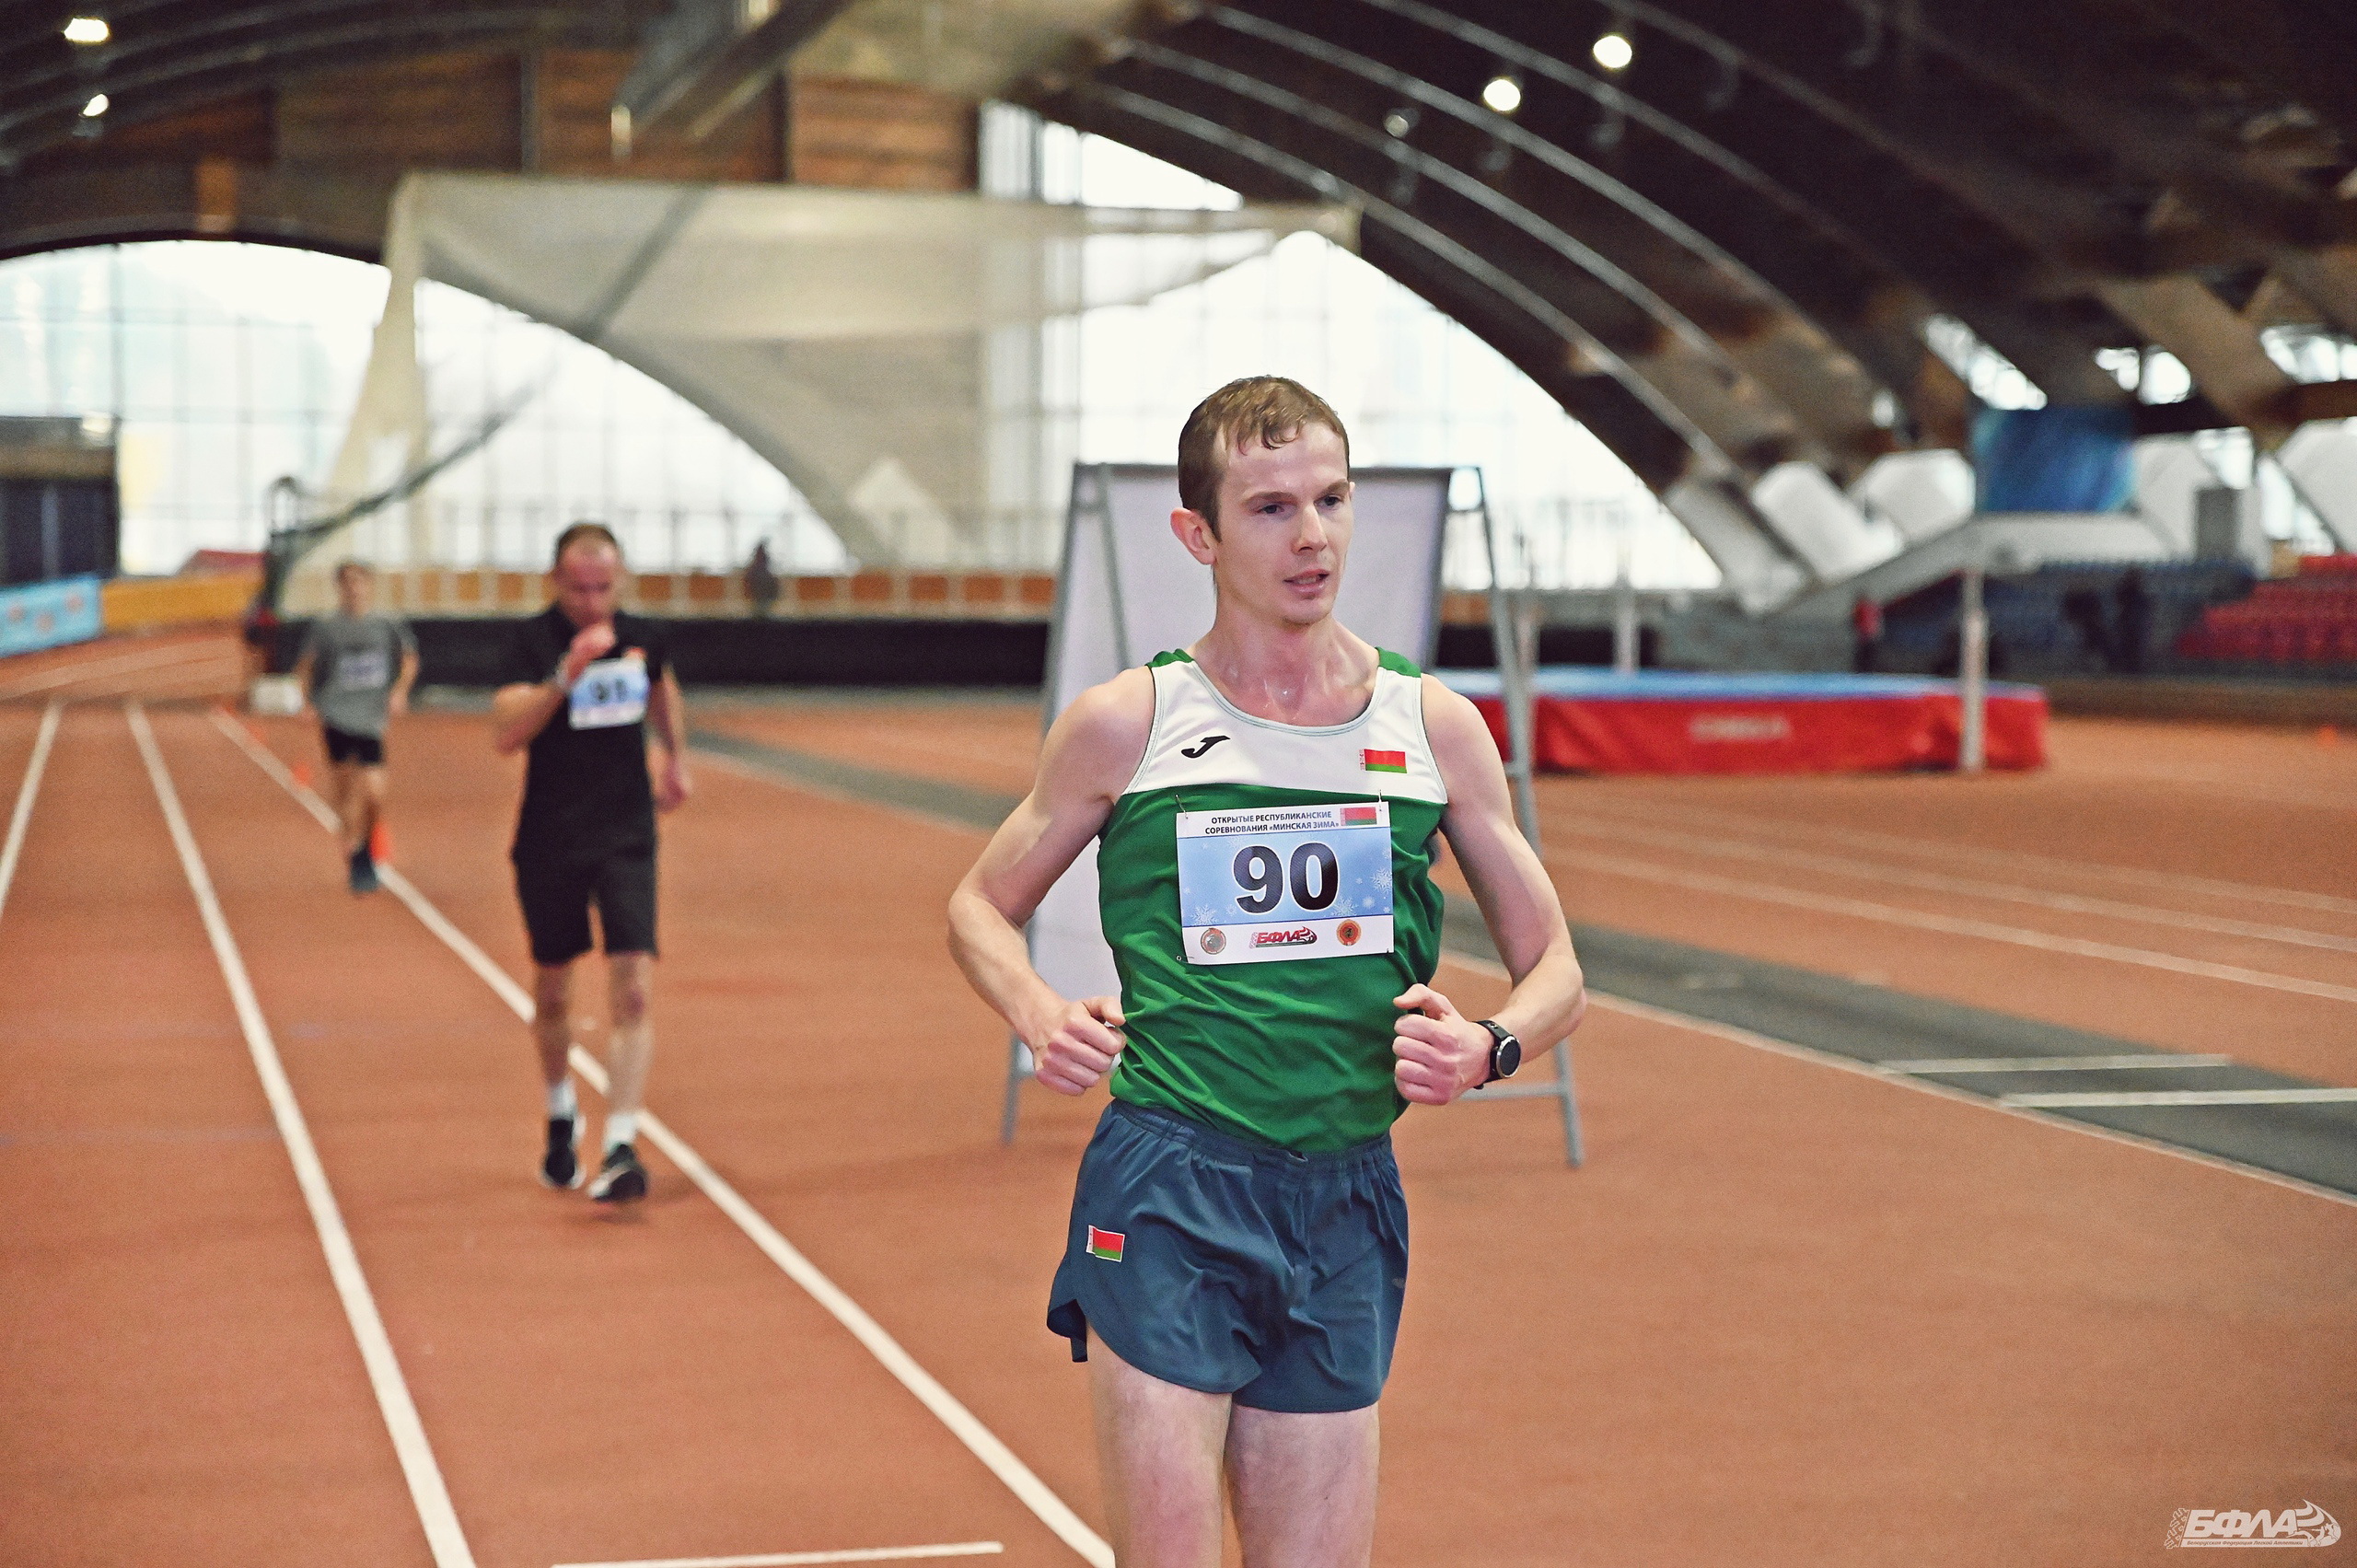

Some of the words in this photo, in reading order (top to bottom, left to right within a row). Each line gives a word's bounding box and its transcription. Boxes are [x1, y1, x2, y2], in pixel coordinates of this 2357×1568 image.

[1211, 815, 1254, 825] ОТКРЫТЫЕ
[1255, 810, 1333, 822] РЕСПУБЛИКАНСКИЕ
[1204, 824, 1268, 835] СОРЕВНОВАНИЯ
[1232, 842, 1340, 914] 90
[1256, 930, 1301, 944] БФЛА
